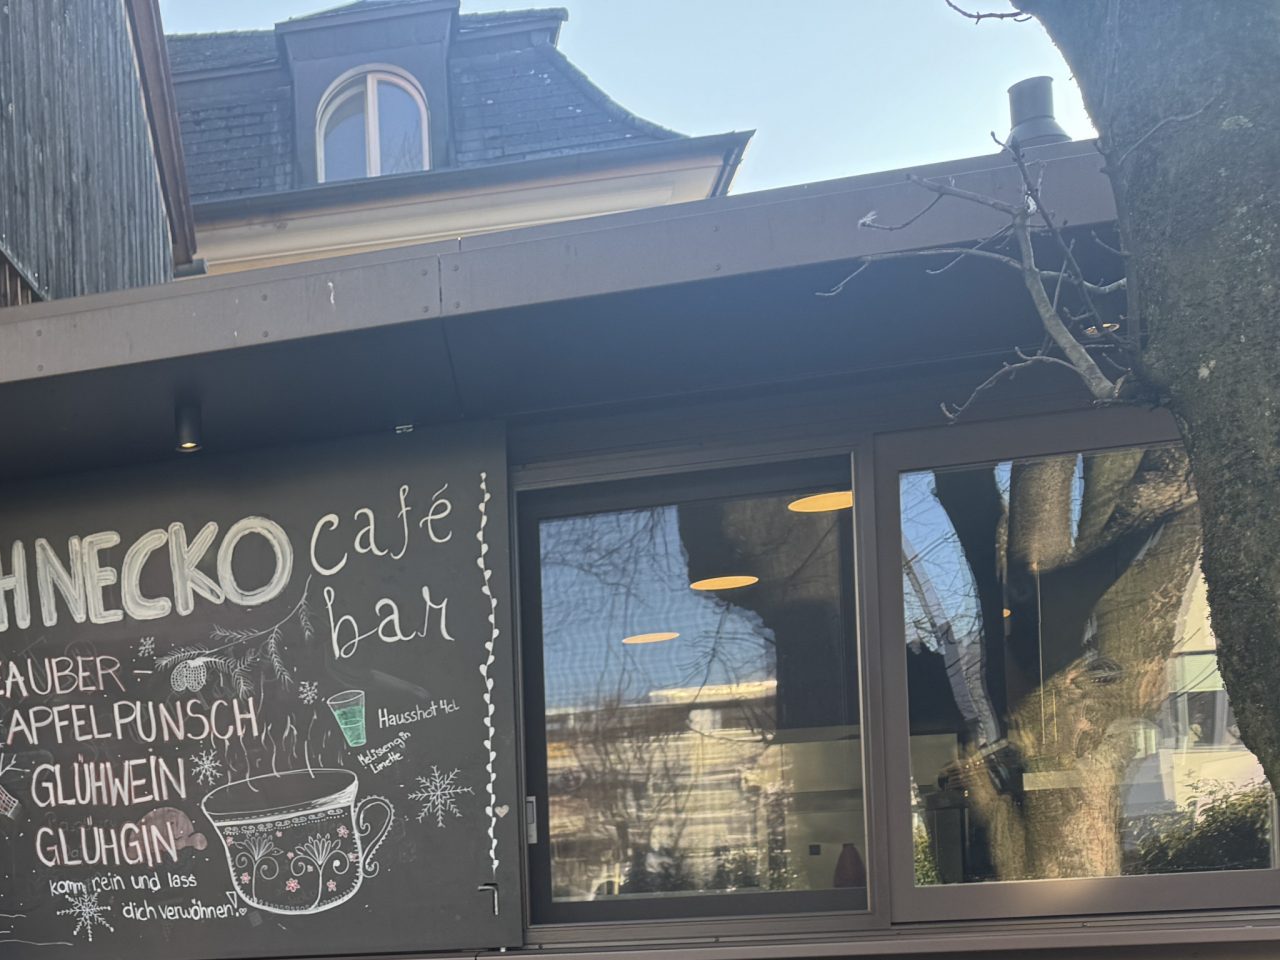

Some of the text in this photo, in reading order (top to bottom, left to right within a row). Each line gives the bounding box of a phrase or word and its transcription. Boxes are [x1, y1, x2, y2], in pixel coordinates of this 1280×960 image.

[310, 483, 453, 576] café
[323, 586, 455, 660] bar
[7, 697, 259, 743] APFELPUNSCH
[378, 701, 438, 728] Hausshot
[31, 754, 187, 807] GLÜHWEIN
[35, 816, 178, 867] GLÜHGIN
[49, 872, 198, 897] komm rein und lass
[122, 900, 157, 921] dich
